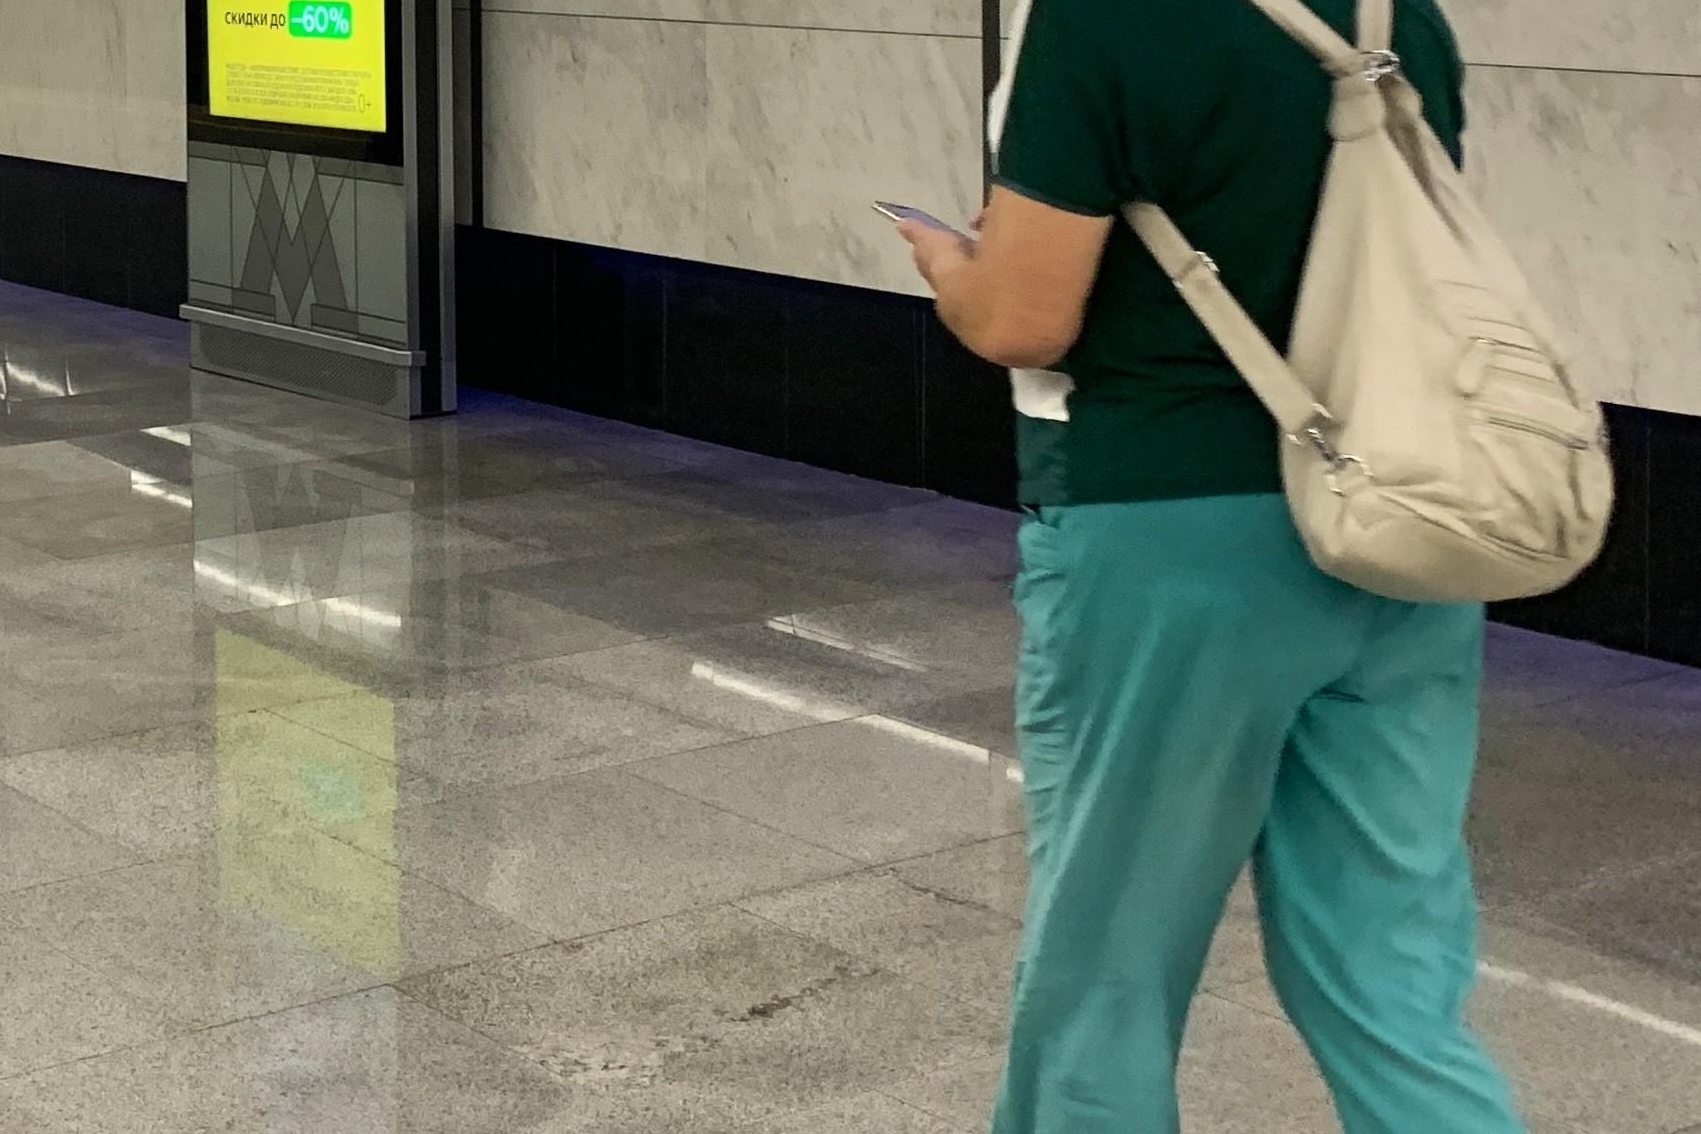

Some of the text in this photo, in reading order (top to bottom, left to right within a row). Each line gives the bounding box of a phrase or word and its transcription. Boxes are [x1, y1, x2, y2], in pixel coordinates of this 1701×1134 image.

[224, 4, 349, 35] скидки до -60%
